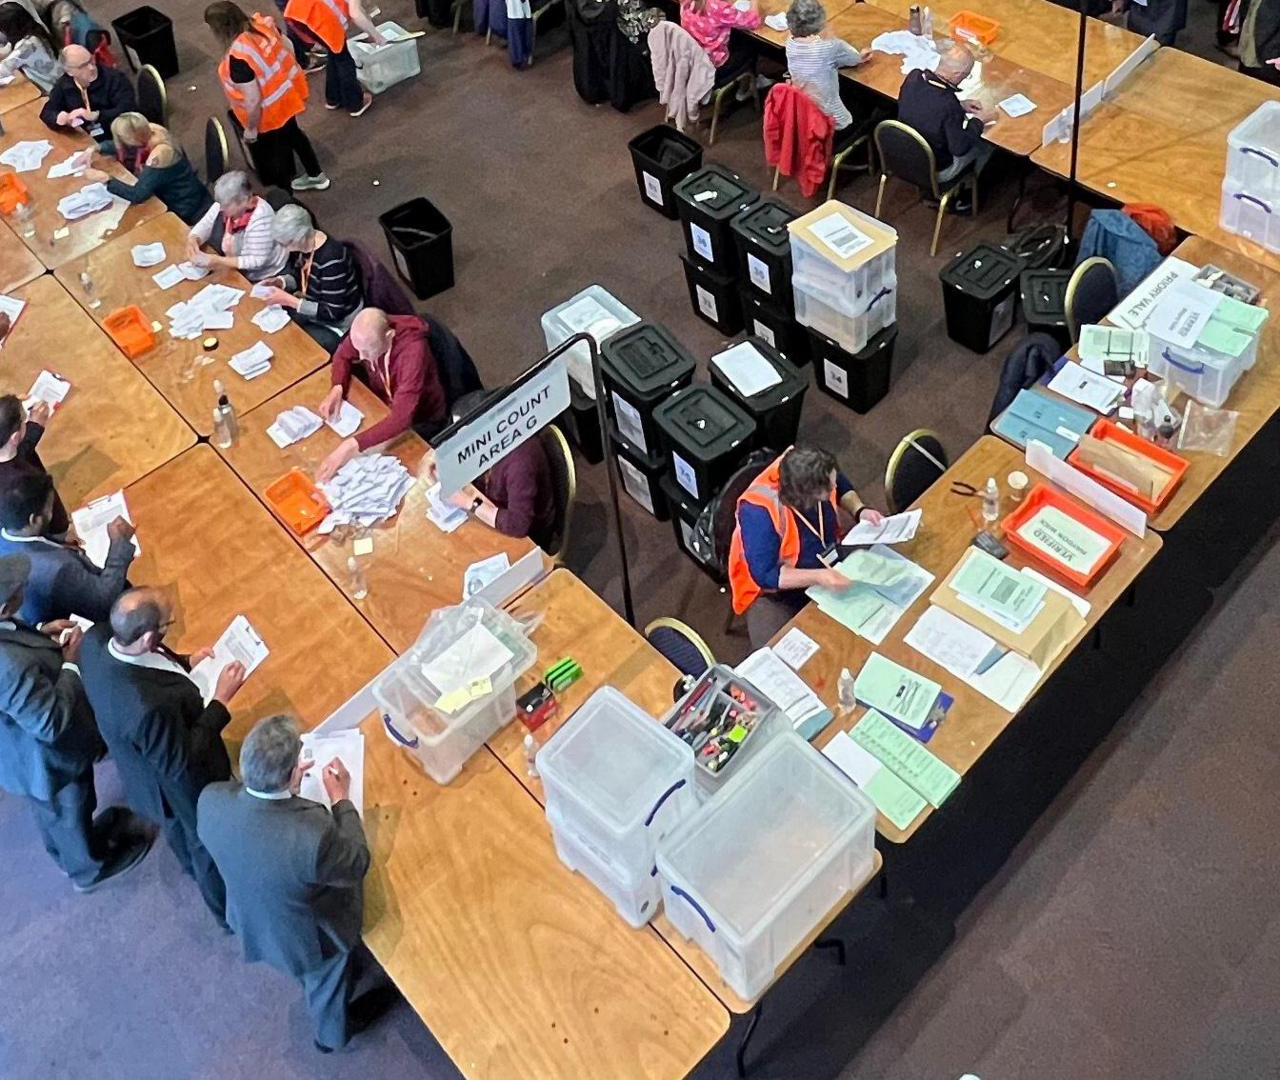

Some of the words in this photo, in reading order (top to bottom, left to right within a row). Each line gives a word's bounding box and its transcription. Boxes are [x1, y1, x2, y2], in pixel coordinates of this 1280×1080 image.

[1149, 271, 1179, 300] PRIORY
[1128, 296, 1152, 317] VALE
[457, 431, 492, 464] MINI
[496, 385, 550, 434] COUNT
[479, 429, 522, 468] AREA
[526, 415, 538, 430] G
[1033, 528, 1073, 562] VERIFIED
